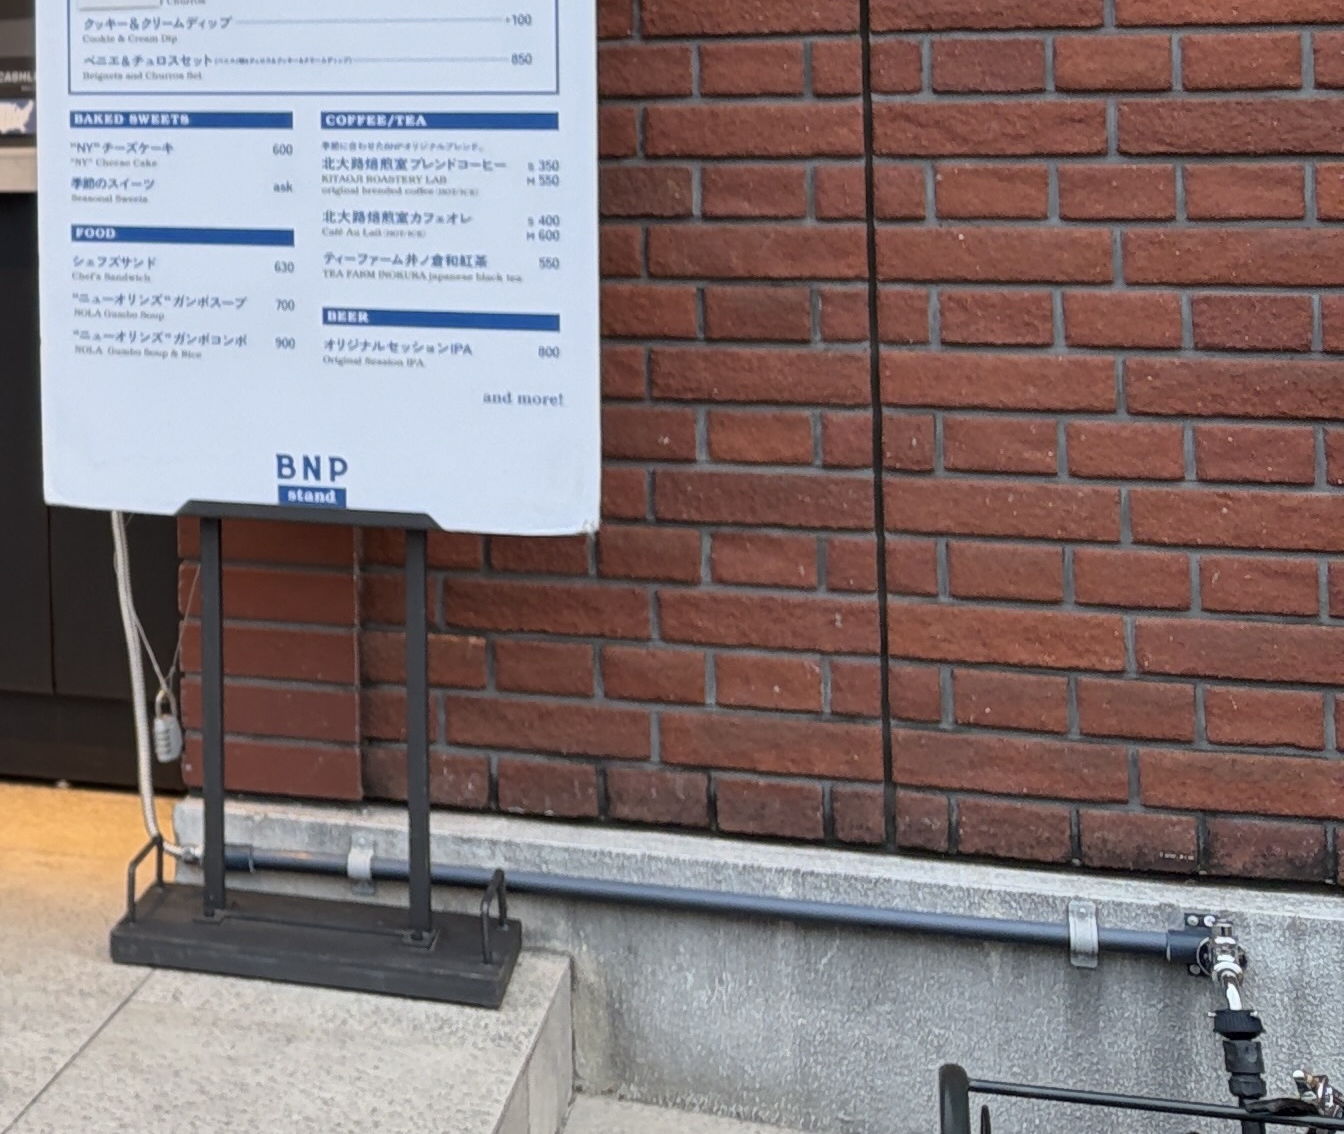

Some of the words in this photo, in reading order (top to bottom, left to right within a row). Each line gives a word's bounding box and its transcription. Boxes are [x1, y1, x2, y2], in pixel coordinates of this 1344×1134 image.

[82, 33, 115, 44] Cookie
[127, 33, 158, 43] Cream
[161, 33, 178, 45] Dip
[510, 52, 532, 66] 850
[125, 71, 143, 81] and
[74, 114, 124, 126] BAKED
[128, 114, 190, 126] SWEETS
[325, 114, 428, 128] COFFEE/TEA
[272, 143, 294, 156] 600
[96, 158, 131, 168] Cheese
[132, 158, 158, 168] Cake
[538, 159, 560, 172] 350
[71, 176, 156, 190] 季節のスイーツ
[273, 180, 293, 192] ask
[321, 174, 363, 184] KITAOJI
[365, 175, 423, 185] ROASTERY
[425, 175, 447, 185] LAB
[526, 176, 536, 186] M
[538, 173, 560, 187] 550
[71, 193, 113, 203] Seasonal
[115, 194, 148, 204] Sweets
[321, 186, 359, 197] original
[404, 186, 434, 196] coffee
[538, 214, 560, 227] 400
[75, 227, 116, 239] FOOD
[526, 231, 536, 241] M
[538, 229, 560, 242] 600
[72, 255, 157, 270] シェフズサンド
[274, 260, 295, 274] 630
[538, 256, 560, 270] 550
[104, 272, 151, 283] Sandwich
[323, 269, 344, 279] TEA
[346, 270, 376, 280] FARM
[378, 270, 428, 281] INOKURA
[475, 272, 503, 282] black
[506, 274, 523, 283] tea
[276, 298, 295, 312] 700
[74, 308, 102, 318] NOLA
[103, 309, 138, 320] Gumbo
[140, 310, 165, 322] Soup
[326, 310, 370, 324] BEER
[275, 337, 296, 351] 900
[74, 345, 103, 355] NOLA
[107, 346, 141, 357] Gumbo
[143, 348, 169, 359] Soup
[538, 345, 560, 359] 800
[322, 355, 362, 367] Original
[364, 357, 404, 367] Session
[406, 358, 425, 368] IPA
[482, 390, 513, 405] and
[517, 392, 564, 407] more!
[275, 454, 348, 482] BNP
[286, 487, 337, 505] stand
